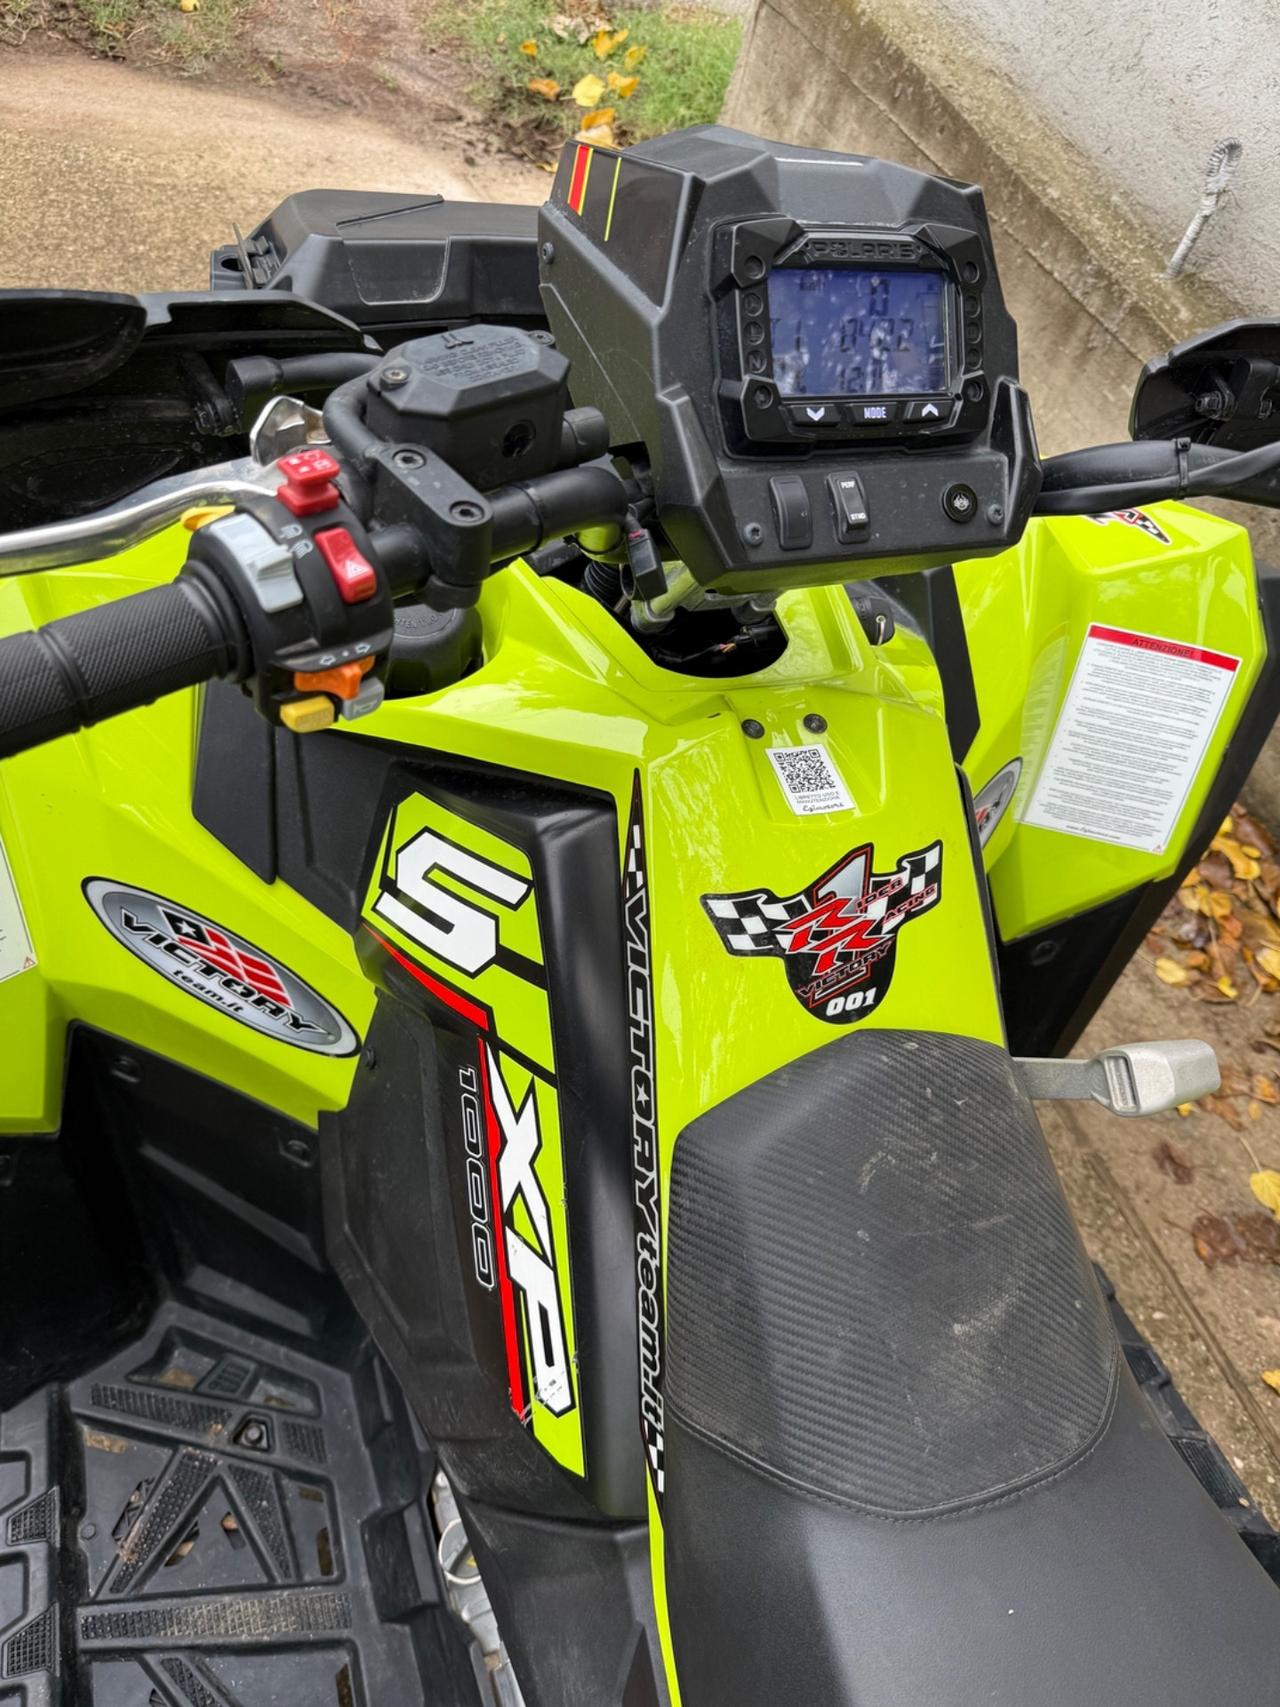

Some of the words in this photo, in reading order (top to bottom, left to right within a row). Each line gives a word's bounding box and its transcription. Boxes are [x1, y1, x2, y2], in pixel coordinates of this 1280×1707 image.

[812, 241, 916, 259] POLARIS
[864, 407, 886, 418] MODE
[1131, 639, 1193, 657] ATTENZIONE!
[120, 906, 328, 1037] VICTORY
[796, 941, 892, 996] VICTORY
[173, 969, 244, 1014] team.it
[825, 988, 876, 1016] 001
[458, 1066, 497, 1291] 1000
[483, 1040, 576, 1416] XP
